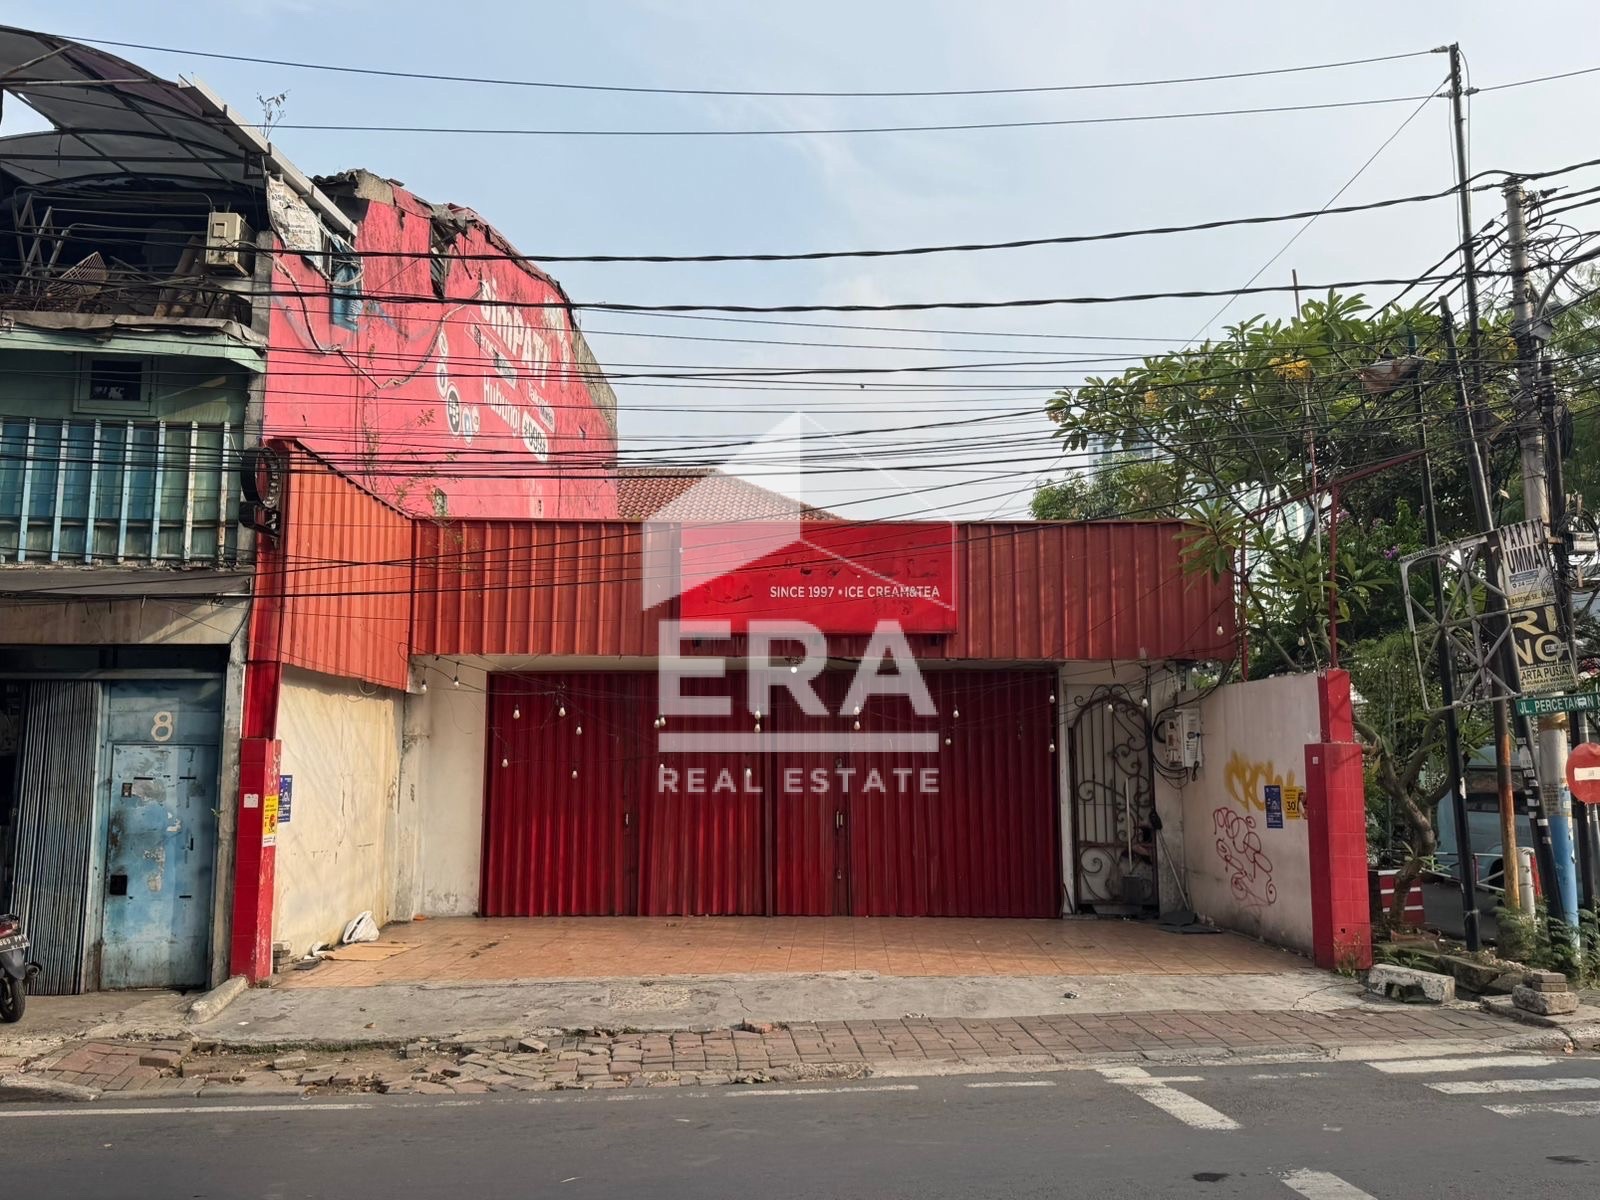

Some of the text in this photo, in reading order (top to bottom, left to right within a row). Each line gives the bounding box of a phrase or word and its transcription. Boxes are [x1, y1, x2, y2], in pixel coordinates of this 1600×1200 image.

[482, 371, 521, 438] Hubungi
[769, 586, 805, 598] SINCE
[808, 586, 835, 598] 1997
[844, 586, 864, 598] ICE
[1543, 664, 1573, 677] PUSAT
[1519, 702, 1533, 714] JL.
[151, 711, 173, 742] 8
[1286, 800, 1297, 811] 30
